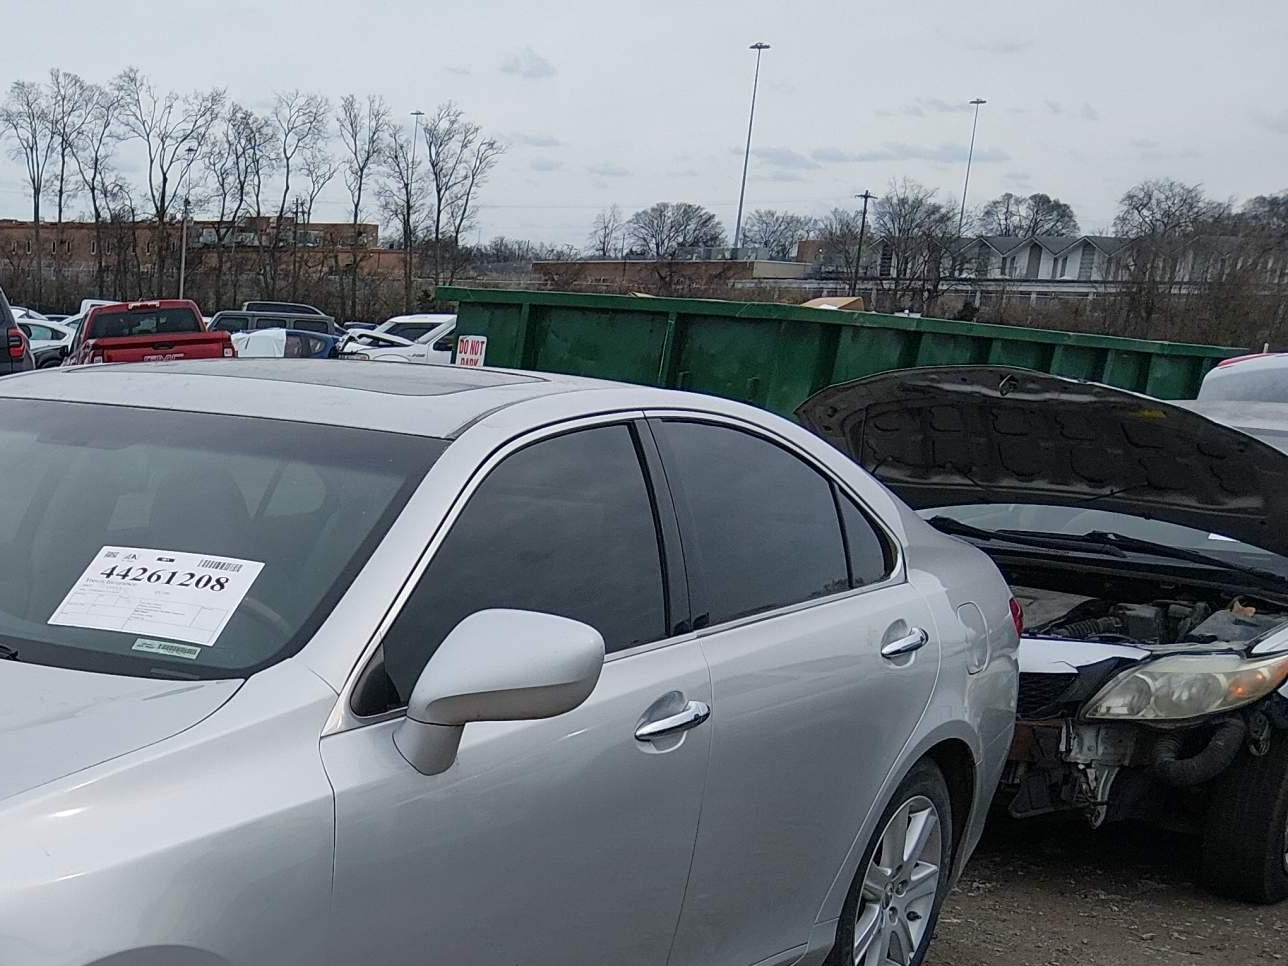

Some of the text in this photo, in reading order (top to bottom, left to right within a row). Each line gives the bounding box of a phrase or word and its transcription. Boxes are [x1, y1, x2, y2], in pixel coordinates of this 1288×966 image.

[459, 339, 485, 356] DO NOT
[100, 564, 230, 592] 44261208
